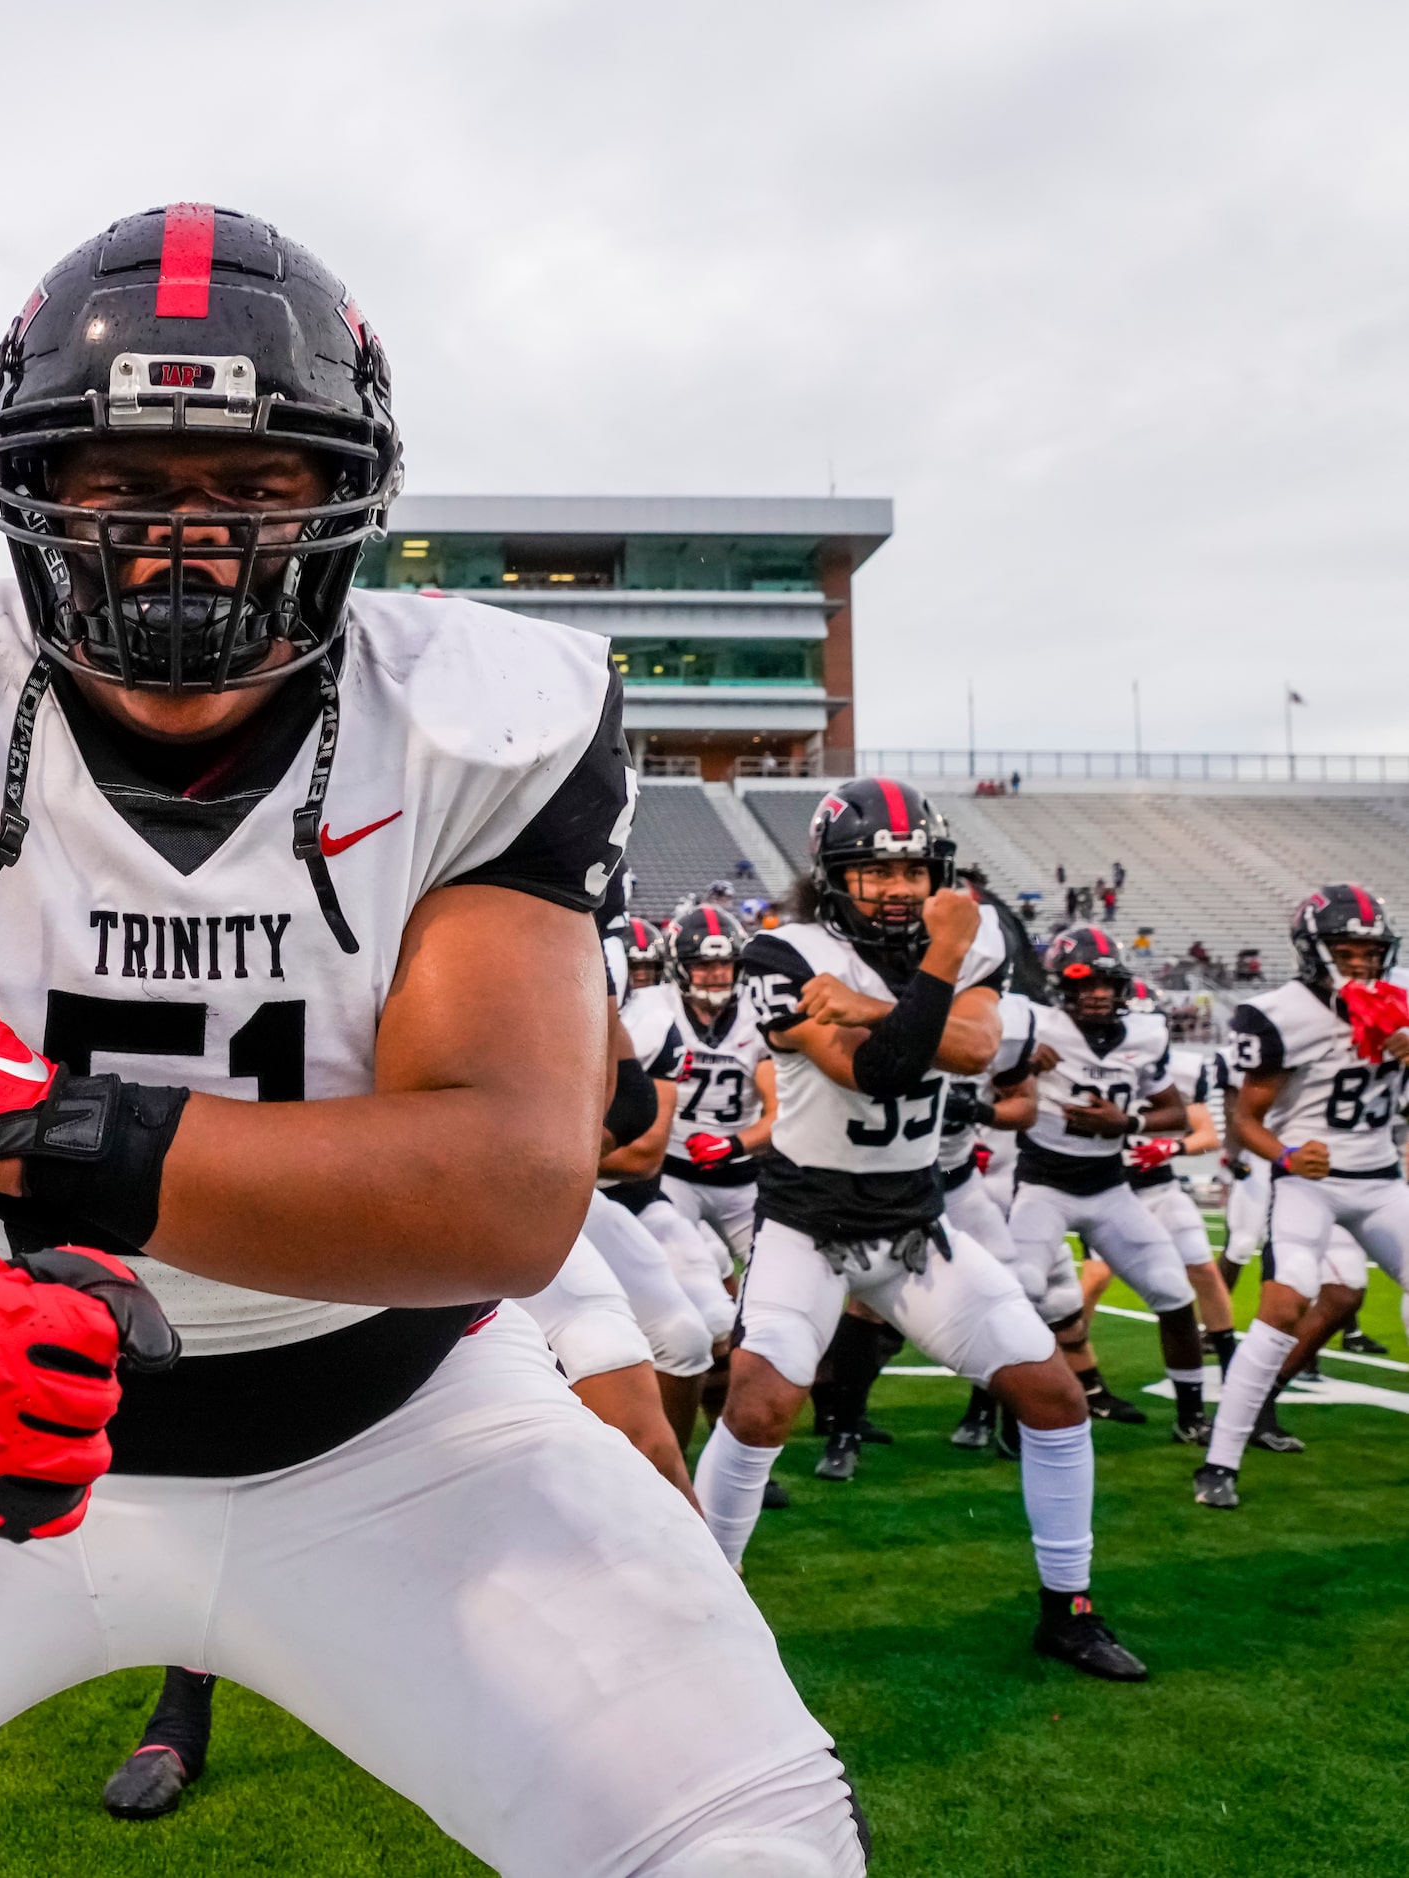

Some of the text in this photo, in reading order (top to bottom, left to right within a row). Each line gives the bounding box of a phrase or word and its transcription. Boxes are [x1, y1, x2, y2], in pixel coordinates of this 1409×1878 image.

[90, 911, 291, 980] TRINITY
[680, 1068, 745, 1122] 73
[1326, 1061, 1400, 1129] 83
